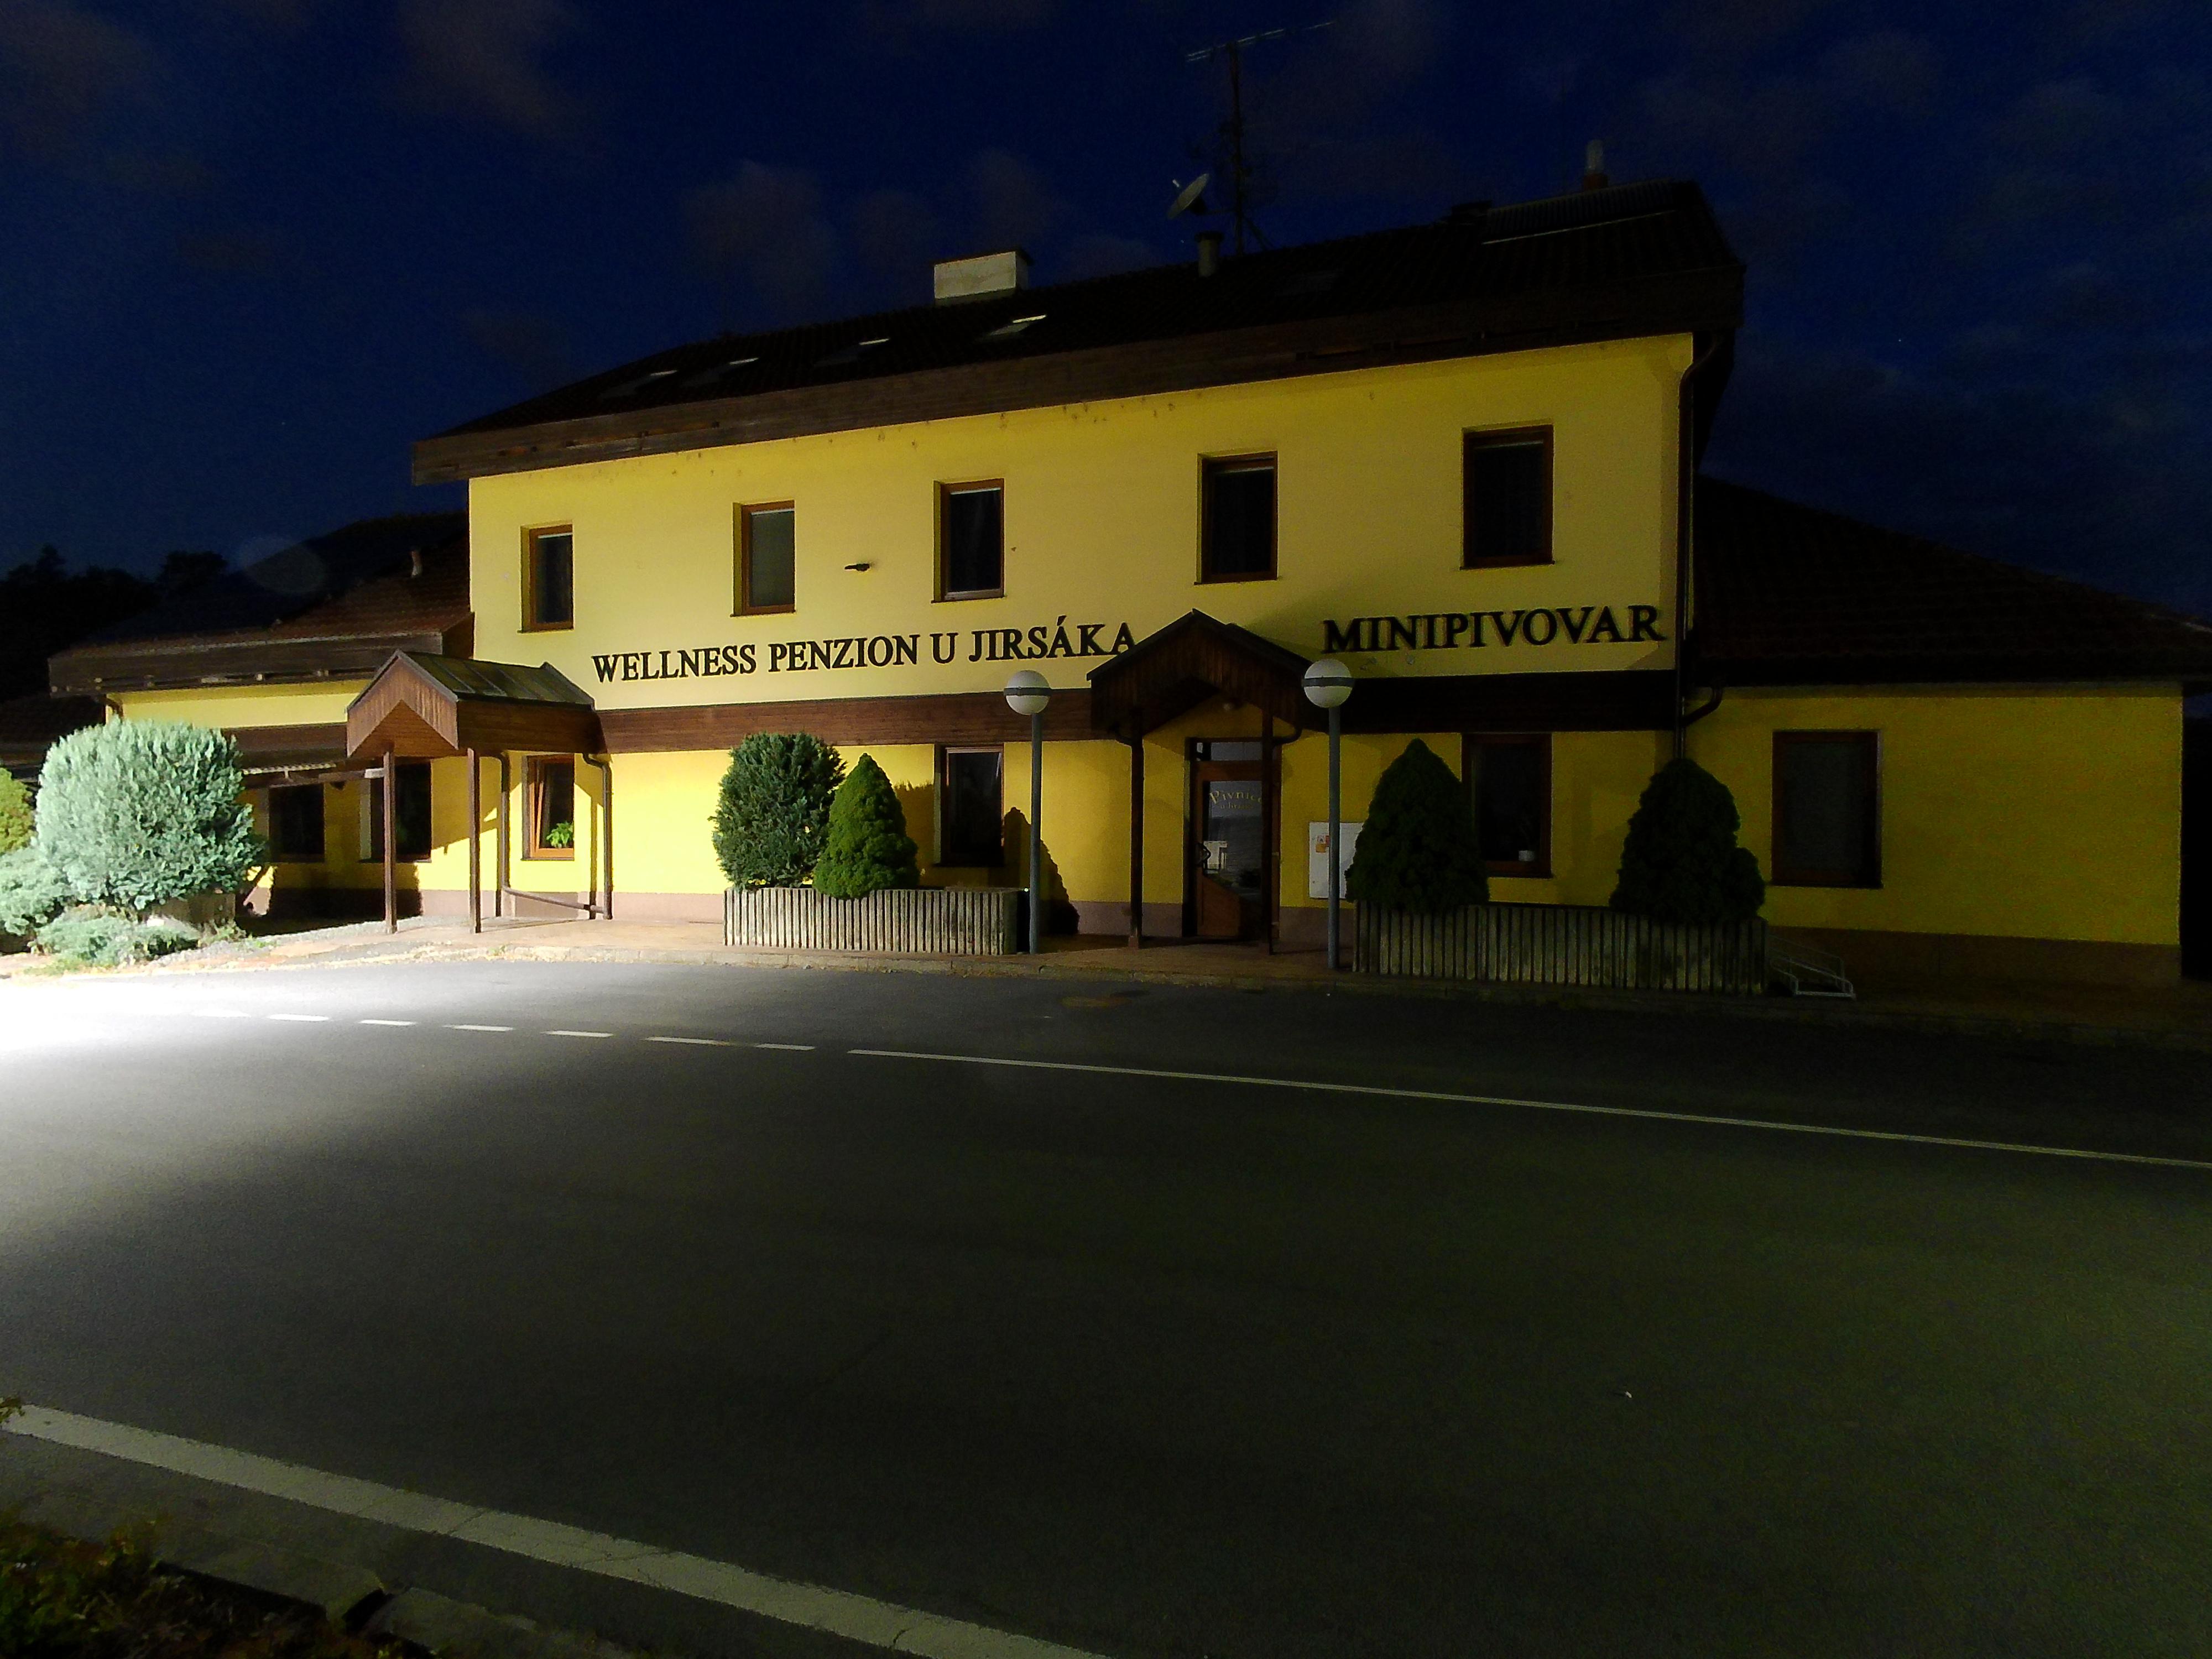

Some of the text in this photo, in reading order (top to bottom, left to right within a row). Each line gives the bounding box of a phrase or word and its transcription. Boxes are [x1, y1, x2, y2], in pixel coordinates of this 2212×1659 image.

[592, 615, 1136, 682] WELLNESS PENZION U JIRSÁKA
[1323, 605, 1666, 654] MINIPIVOVAR
